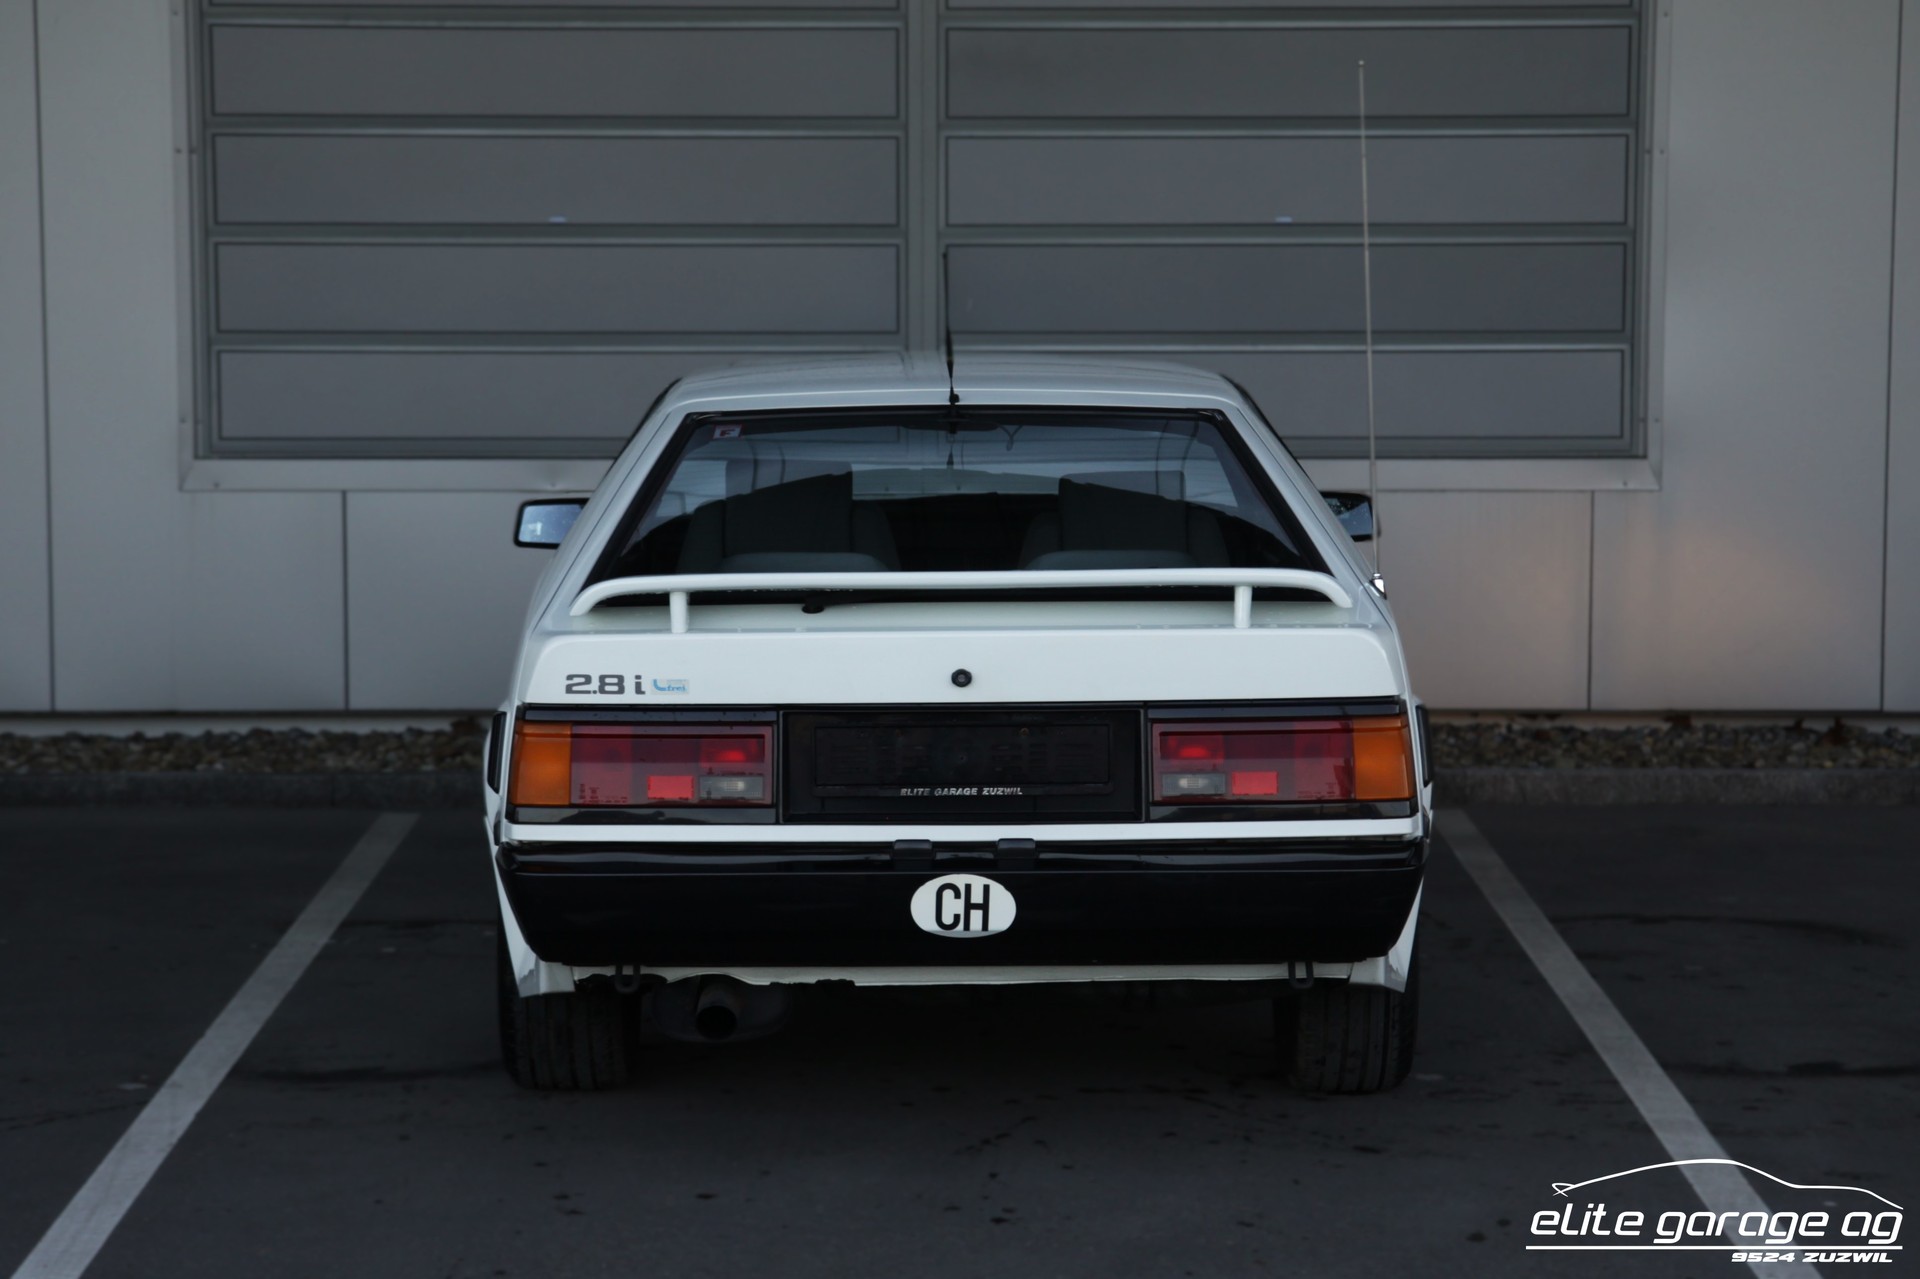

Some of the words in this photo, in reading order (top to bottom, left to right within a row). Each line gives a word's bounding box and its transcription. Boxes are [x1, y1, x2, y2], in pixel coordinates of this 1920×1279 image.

[900, 788, 931, 796] ELITE
[934, 788, 978, 796] GARAGE
[982, 787, 1023, 796] ZUZWIL
[935, 882, 990, 931] CH
